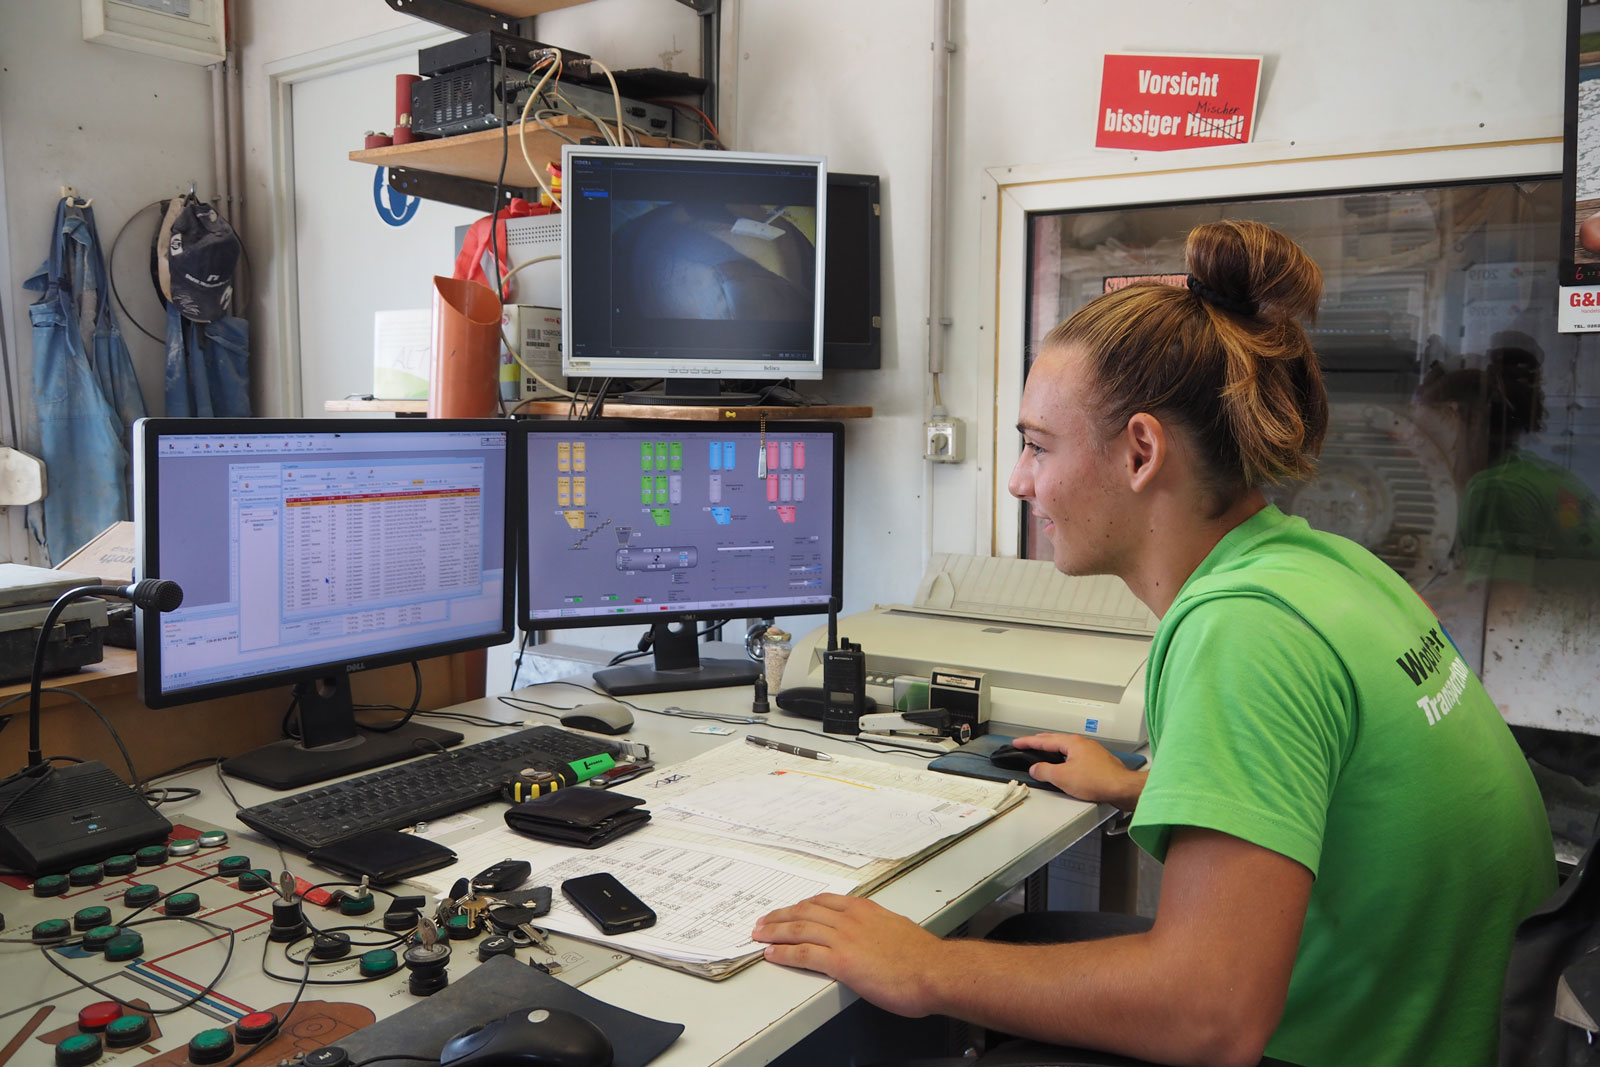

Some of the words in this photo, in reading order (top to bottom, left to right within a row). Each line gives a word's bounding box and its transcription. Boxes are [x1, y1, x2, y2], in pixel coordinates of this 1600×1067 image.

[1138, 69, 1220, 98] Vorsicht
[1195, 101, 1240, 115] Mischer
[1104, 108, 1181, 137] bissiger
[1185, 112, 1245, 140] Hund!
[345, 663, 366, 673] DELL
